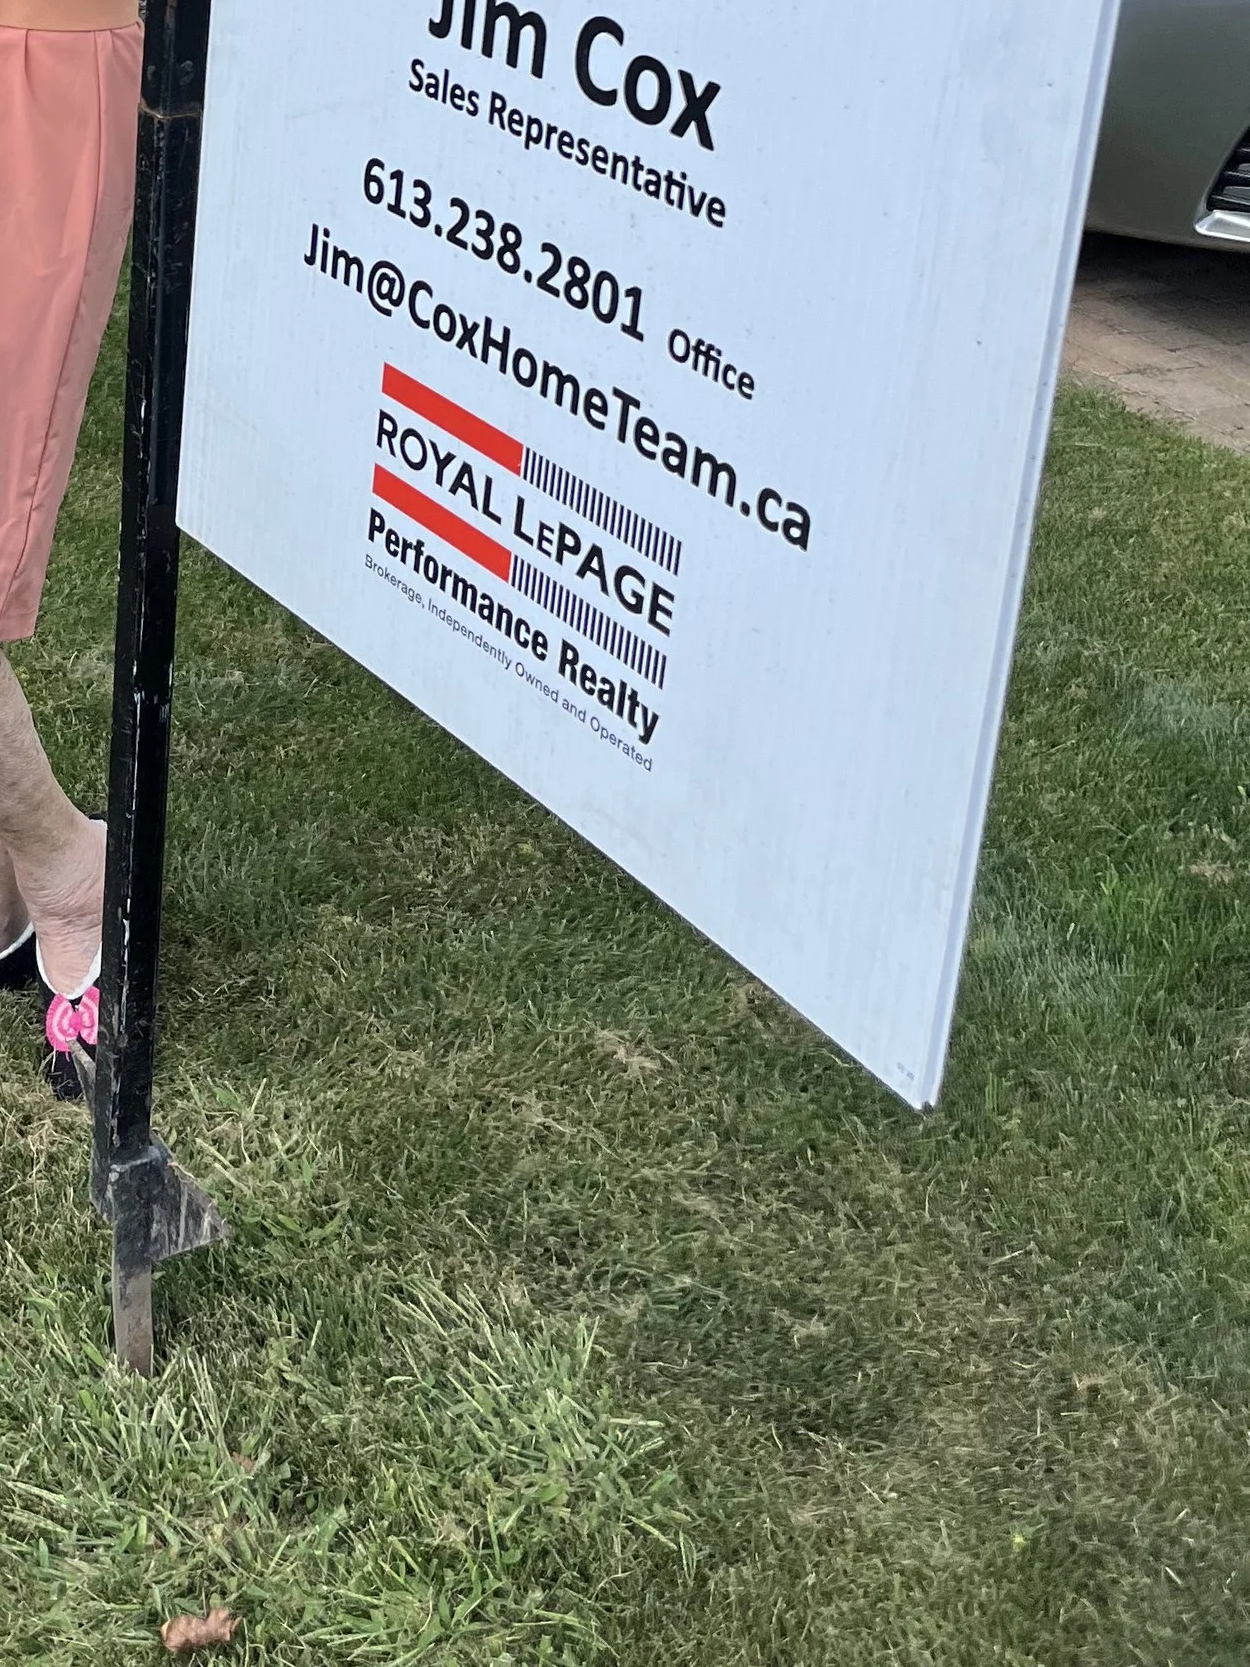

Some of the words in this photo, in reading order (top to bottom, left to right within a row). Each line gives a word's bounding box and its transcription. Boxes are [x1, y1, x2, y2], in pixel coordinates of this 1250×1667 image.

[408, 58, 480, 117] Sales
[488, 90, 727, 229] Representative
[574, 15, 722, 152] Cox
[303, 222, 812, 552] Jim@CoxHomeTeam.ca
[363, 157, 645, 343] 613.238.2801
[667, 328, 755, 401] Office
[376, 408, 502, 526] ROYAL
[364, 553, 425, 610] Brokerage,
[427, 598, 513, 671] Independently
[515, 661, 559, 704] Owned
[561, 698, 587, 724] and
[589, 716, 653, 772] Operated
[367, 506, 549, 662] Performance
[557, 637, 660, 746] Realty
